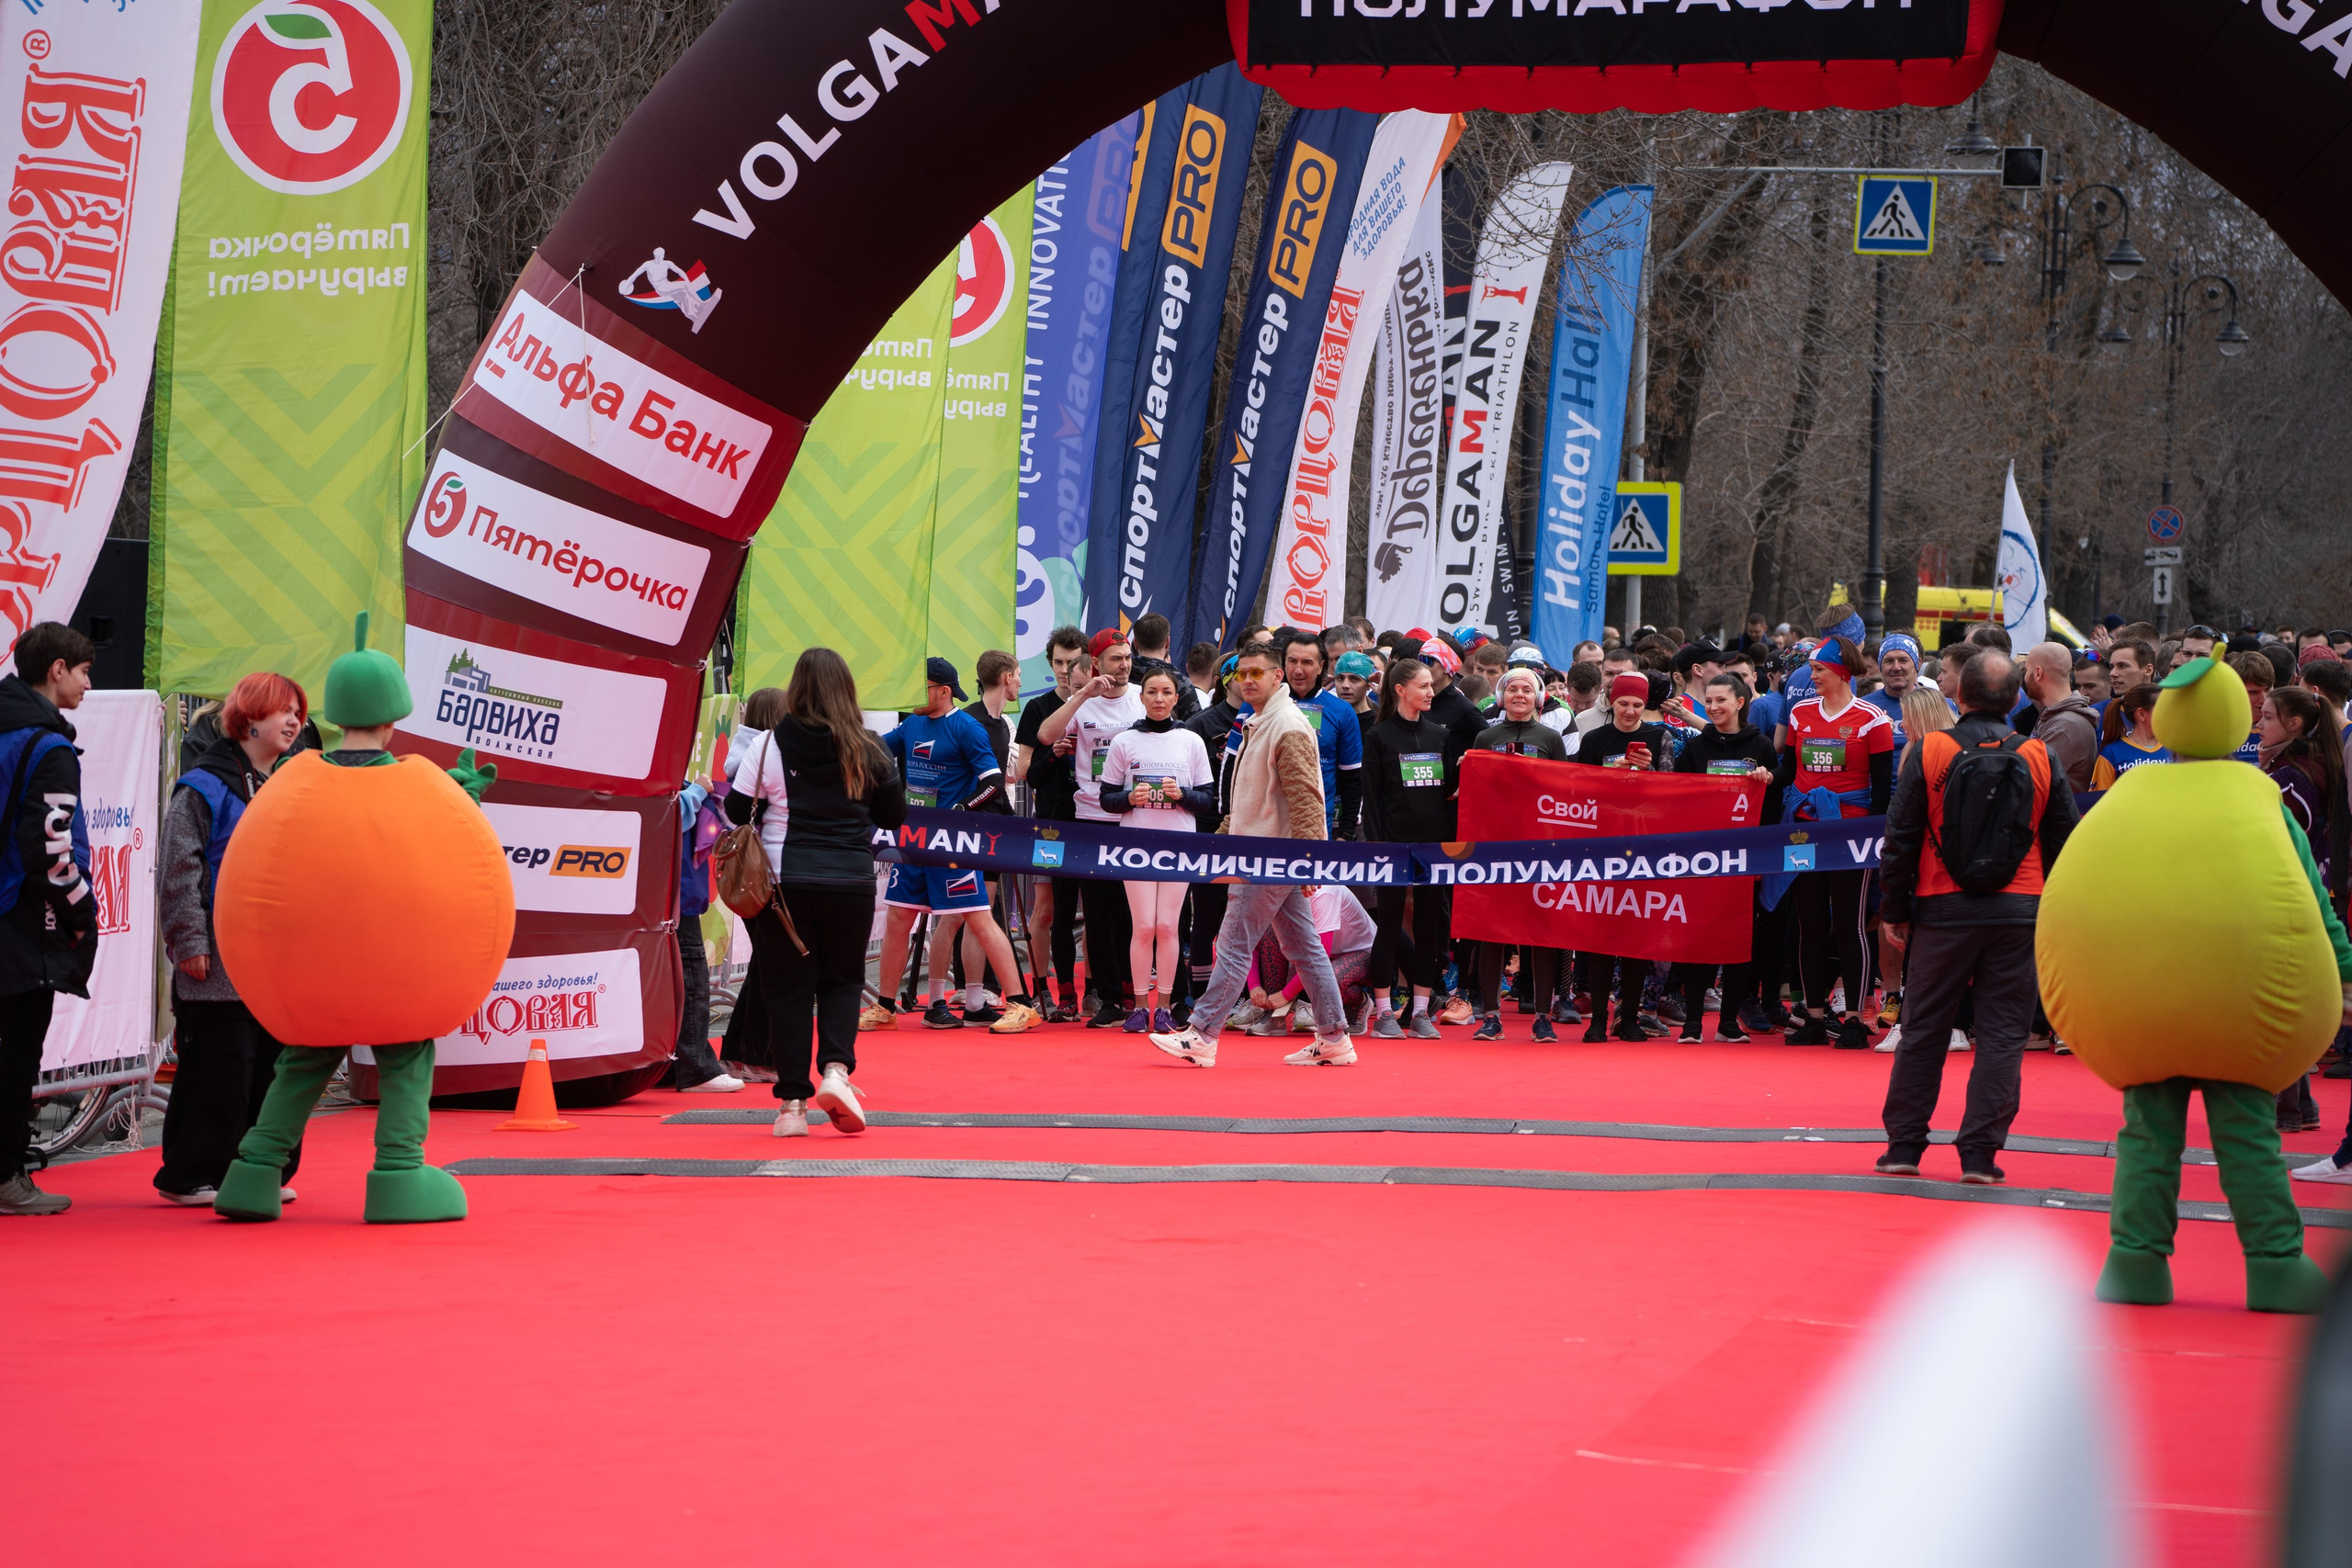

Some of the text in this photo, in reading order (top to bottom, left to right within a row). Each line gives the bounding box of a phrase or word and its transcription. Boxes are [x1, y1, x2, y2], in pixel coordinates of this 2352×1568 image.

[691, 0, 1001, 241] VOLGAM
[1170, 120, 1216, 254] PRO
[1380, 156, 1407, 191] ВОДА
[1026, 152, 1071, 330] INNOVATI
[1273, 158, 1327, 287] PRO
[1352, 182, 1402, 256] ДЛЯ ВАШЕГО
[1361, 194, 1408, 261] ЗДОРОВЬЯ!
[494, 312, 752, 481] Альфа Банк
[1492, 321, 1520, 434] TRIATHLON
[1283, 285, 1365, 636] ВОРЦОВАЯ
[1438, 319, 1501, 636] OLGAMAN
[1544, 410, 1602, 610] Holiday
[468, 504, 689, 612] Пятёрочка
[1496, 543, 1514, 593] SWIM
[1586, 484, 1611, 614] Samara Hotel
[1148, 788, 1164, 801] 06
[1412, 766, 1433, 779] 355
[1812, 751, 1833, 765] 356
[1537, 795, 1598, 822] Свой
[555, 850, 625, 874] PRO
[1097, 844, 1747, 885] КОСМИЧЕСКИЙ ПОЛУМАРАФОН
[1532, 883, 1688, 924] САМАРА
[537, 972, 599, 990] здоровья!
